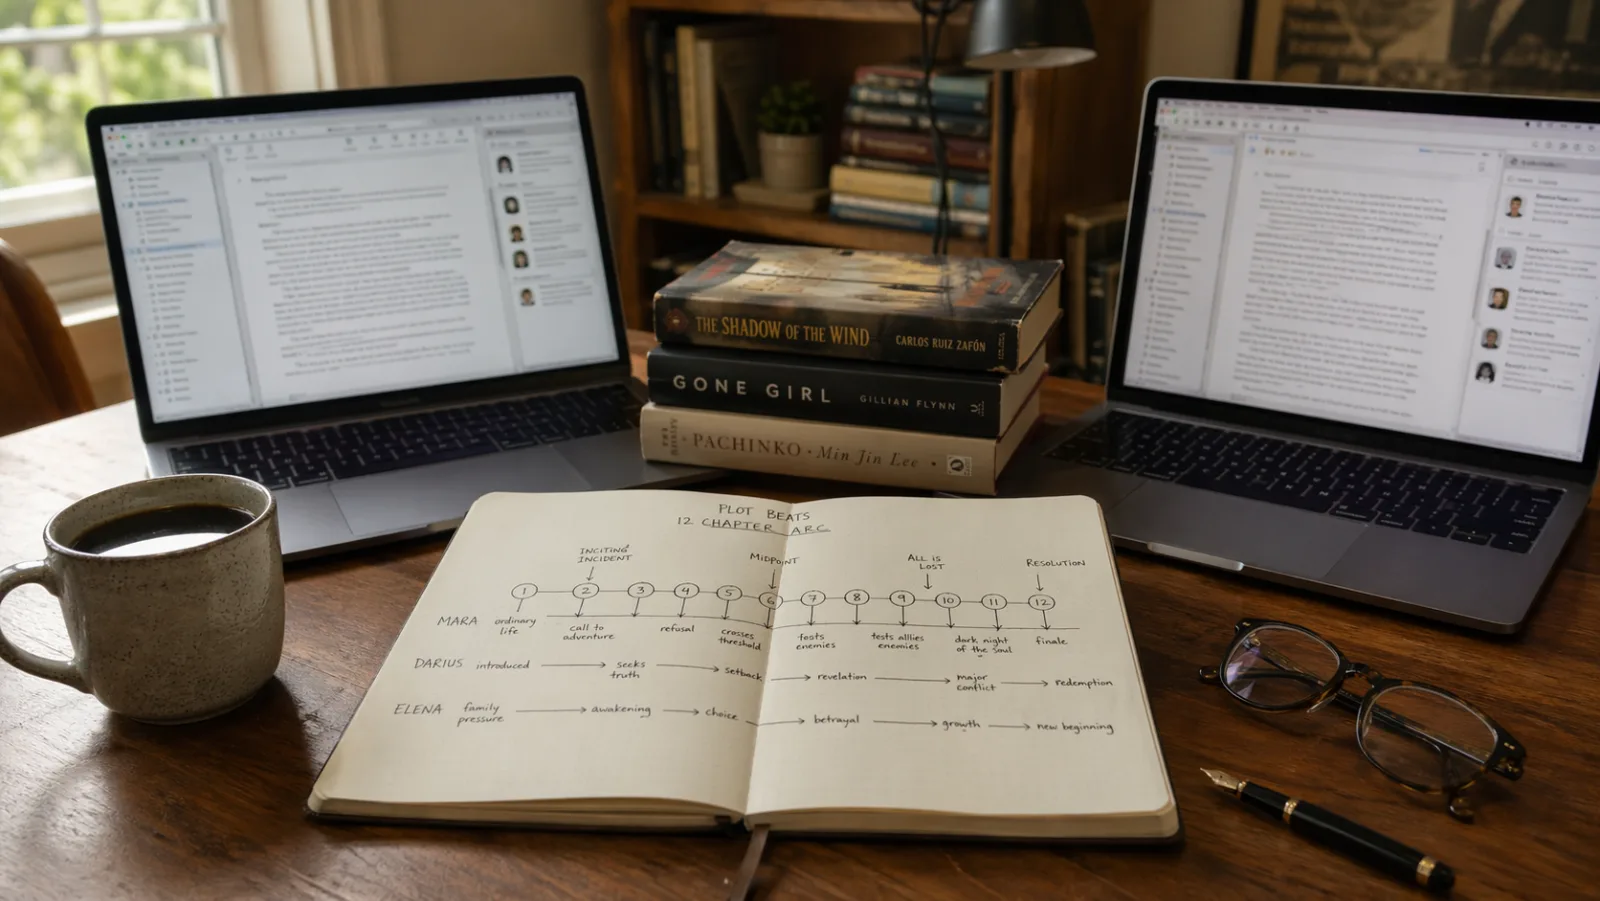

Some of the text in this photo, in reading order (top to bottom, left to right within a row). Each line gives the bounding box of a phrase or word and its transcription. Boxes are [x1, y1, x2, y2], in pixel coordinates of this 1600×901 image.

[696, 316, 870, 347] THE SHADOW OF THE WIND
[896, 335, 929, 348] CARLOS
[932, 339, 953, 350] RUIZ
[956, 338, 986, 352] ZAFÓN
[673, 375, 831, 402] GONE GIRL
[860, 395, 956, 410] GILLIAN FLYNN
[692, 432, 801, 457] PACHINKO
[816, 446, 918, 468] Min Jin Lee
[719, 504, 810, 522] PLOT BEATS
[678, 517, 831, 536] 12 CHAPTER ARC
[578, 554, 632, 563] INCIDENT
[908, 554, 927, 562] ALL
[1026, 558, 1086, 567] RESOLUTION
[582, 586, 591, 594] 2
[637, 586, 645, 594] 3
[682, 586, 690, 595] 4
[725, 589, 735, 597] 5
[766, 596, 775, 605] 6
[853, 593, 861, 602] 8
[898, 594, 906, 602] 9
[437, 616, 479, 626] MARA
[494, 616, 536, 628] ordinary
[500, 627, 519, 635] life
[570, 623, 590, 632] call
[563, 632, 616, 640] adventure
[721, 629, 754, 640] crosses
[871, 632, 894, 641] tests
[718, 636, 762, 650] threshold
[983, 636, 1008, 647] night
[1036, 636, 1068, 645] finale
[796, 642, 836, 650] enemies
[971, 646, 988, 654] the
[994, 646, 1014, 654] soul
[414, 658, 464, 669] DARIUS
[476, 660, 530, 670] introduced
[609, 670, 640, 679] truth
[724, 668, 763, 682] setback
[818, 672, 867, 680] revelation
[956, 674, 988, 684] major
[956, 684, 996, 692] conflict
[1055, 679, 1113, 689] redemption
[394, 703, 444, 715] ELENA
[464, 702, 500, 715] family
[591, 705, 651, 717] awakening
[705, 706, 739, 720] choice
[457, 715, 504, 727] pressure
[814, 714, 860, 728] betrayal
[942, 720, 980, 731] growth
[1037, 722, 1114, 735] new beginning
